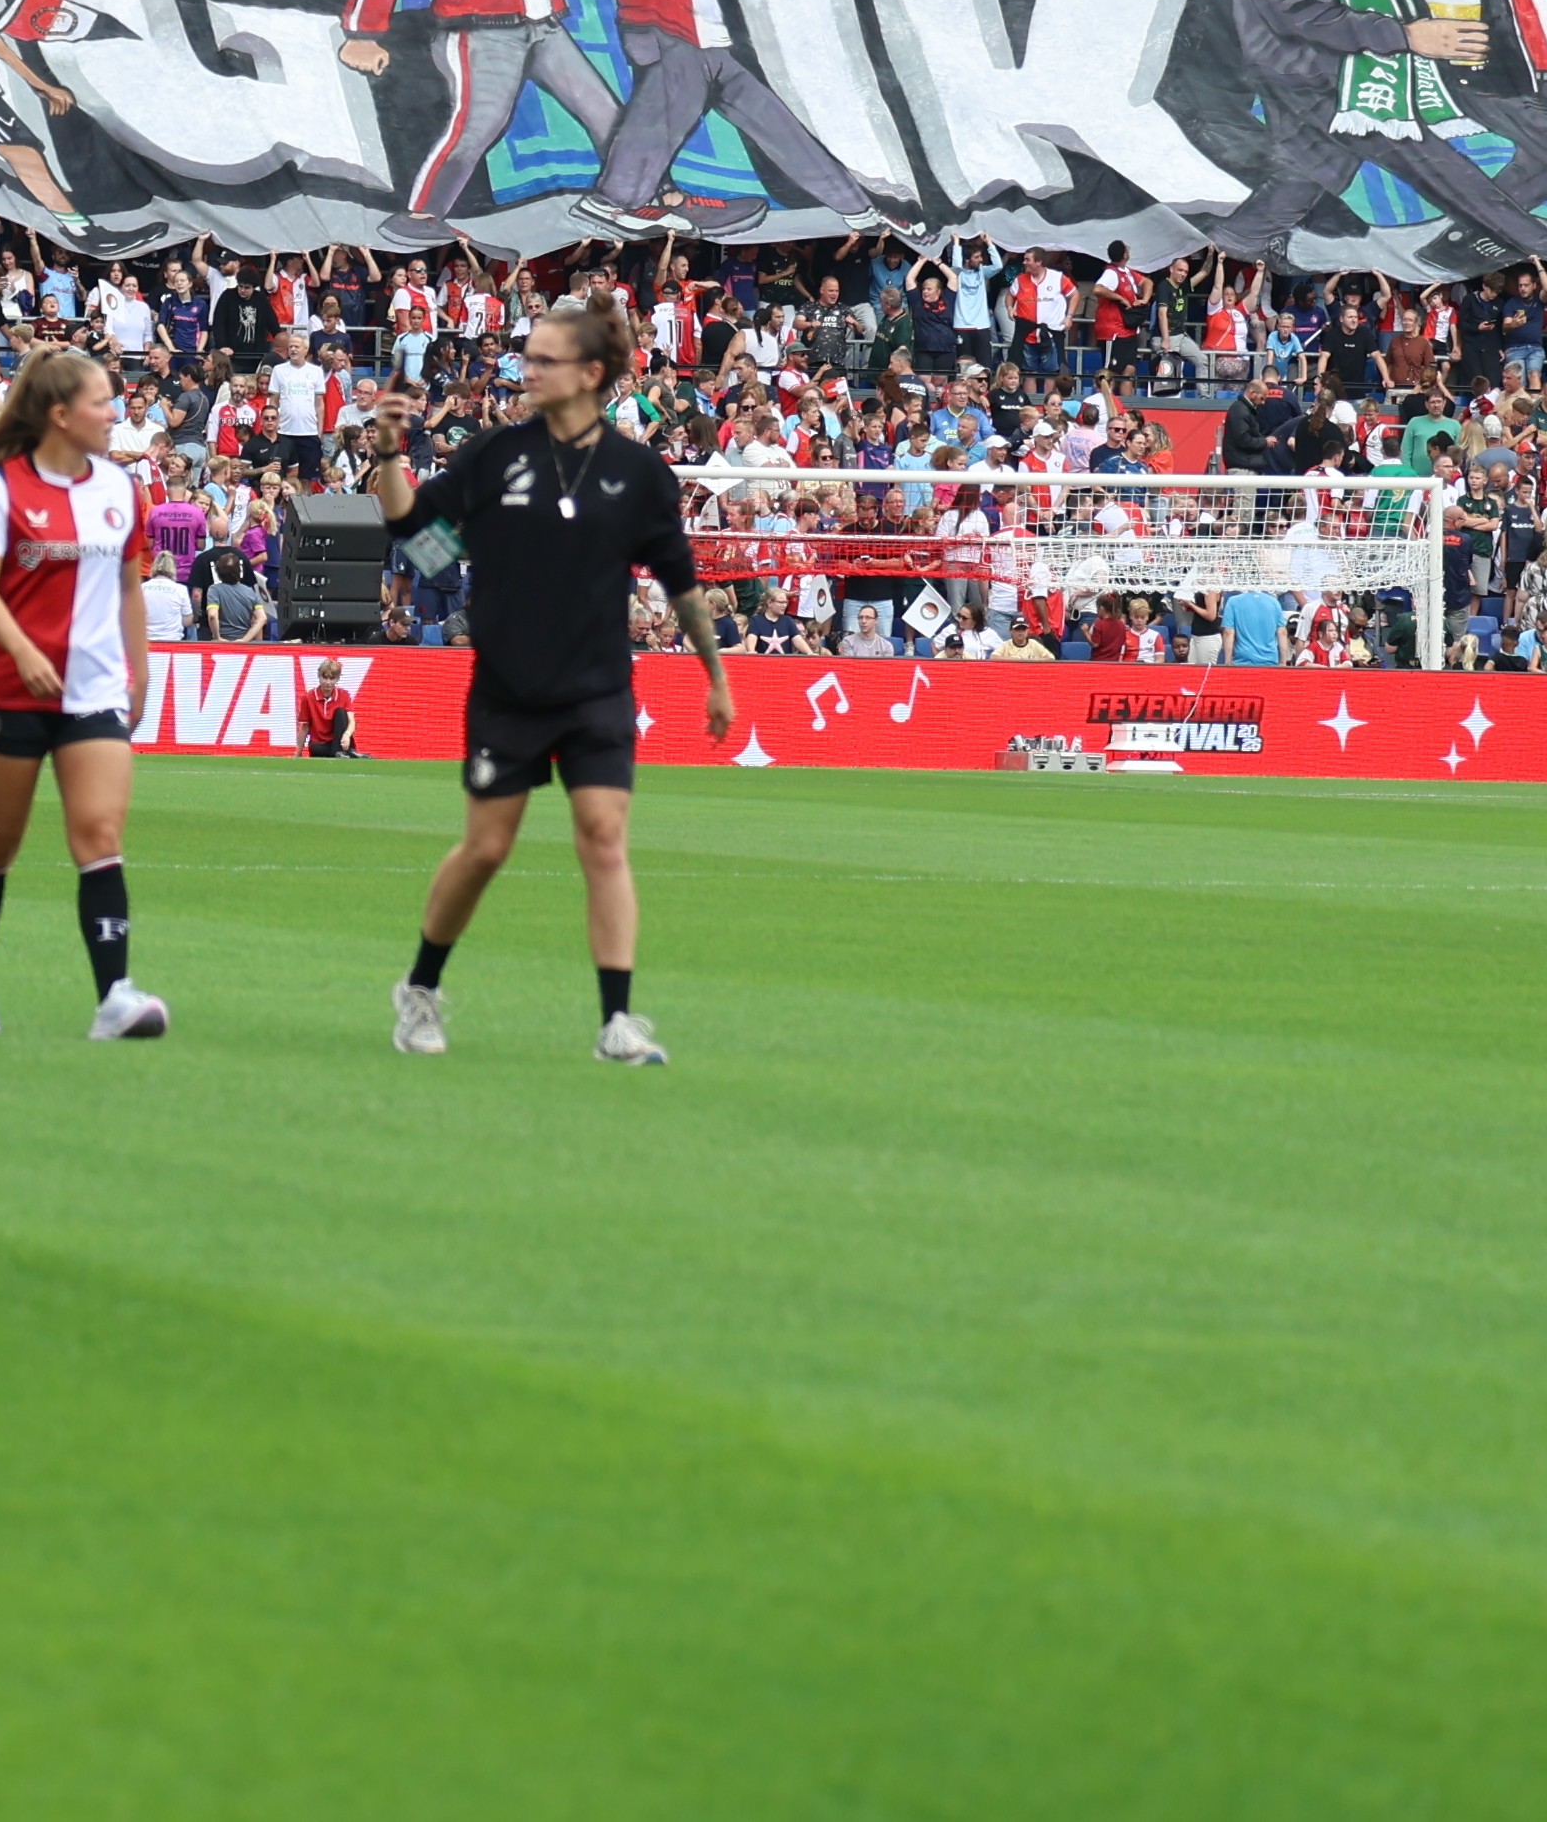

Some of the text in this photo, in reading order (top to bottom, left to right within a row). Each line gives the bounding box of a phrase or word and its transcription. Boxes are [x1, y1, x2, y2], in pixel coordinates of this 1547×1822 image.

[667, 319, 683, 346] 11
[219, 417, 255, 428] FORTIS
[160, 526, 190, 557] 010
[1092, 694, 1263, 723] FEYENOORD
[1238, 724, 1258, 738] 20
[94, 917, 129, 942] F
